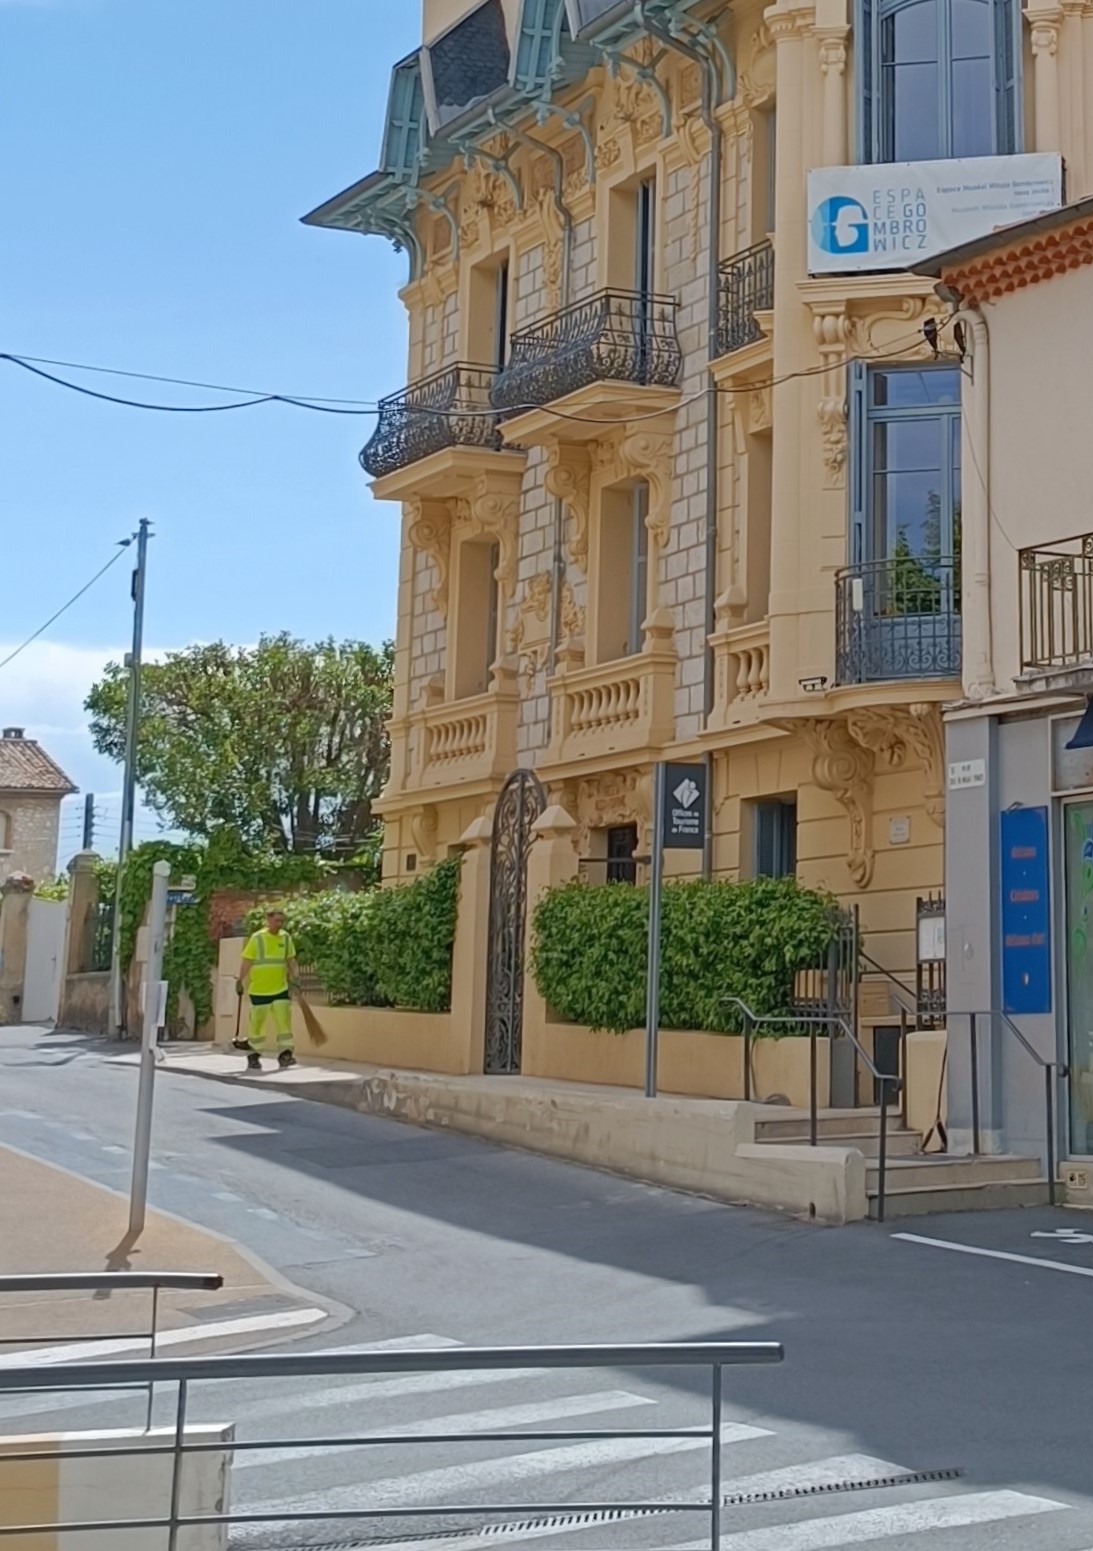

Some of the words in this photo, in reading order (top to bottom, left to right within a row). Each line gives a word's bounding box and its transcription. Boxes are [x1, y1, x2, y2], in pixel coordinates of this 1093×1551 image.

[873, 187, 926, 205] ESPA
[873, 218, 927, 236] MBRO
[873, 234, 928, 253] WICZ
